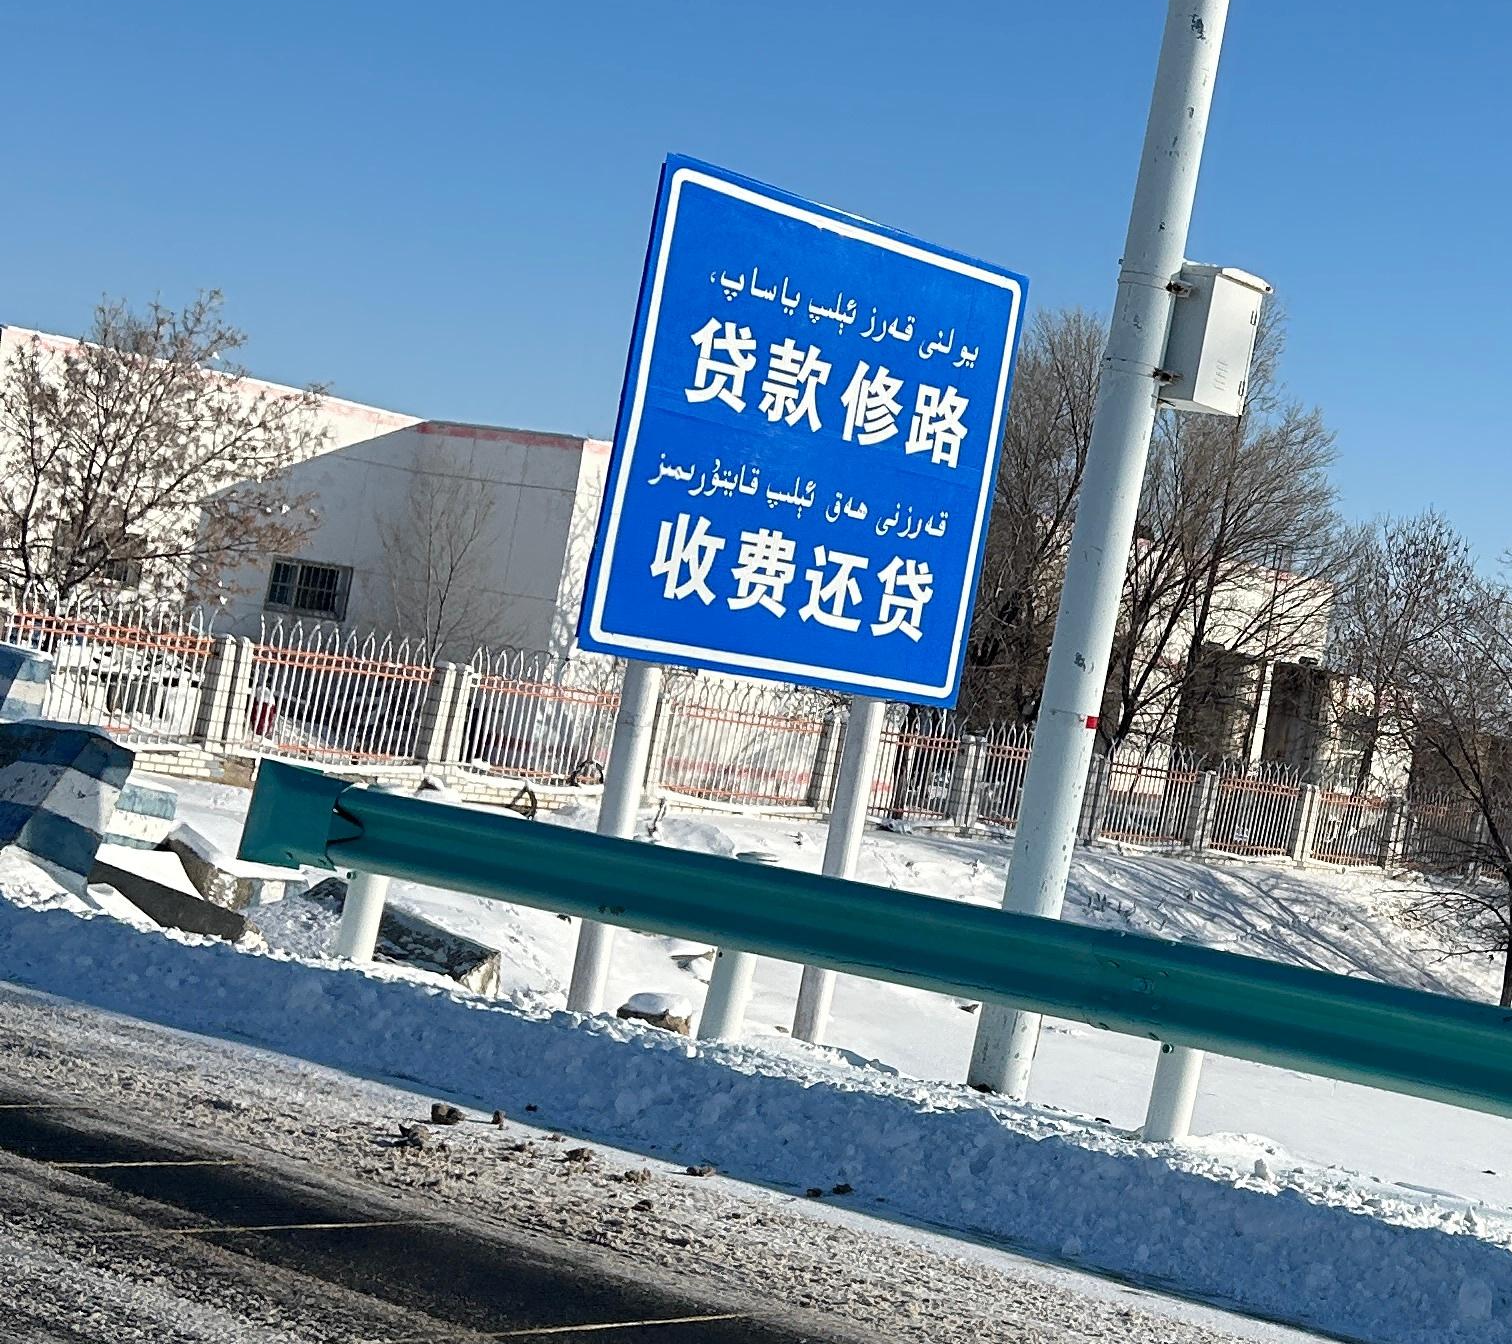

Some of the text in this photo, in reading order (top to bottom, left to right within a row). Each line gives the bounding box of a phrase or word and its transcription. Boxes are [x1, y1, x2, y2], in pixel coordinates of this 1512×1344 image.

[684, 317, 970, 470] 贷款修路
[649, 512, 935, 643] 收费还贷
